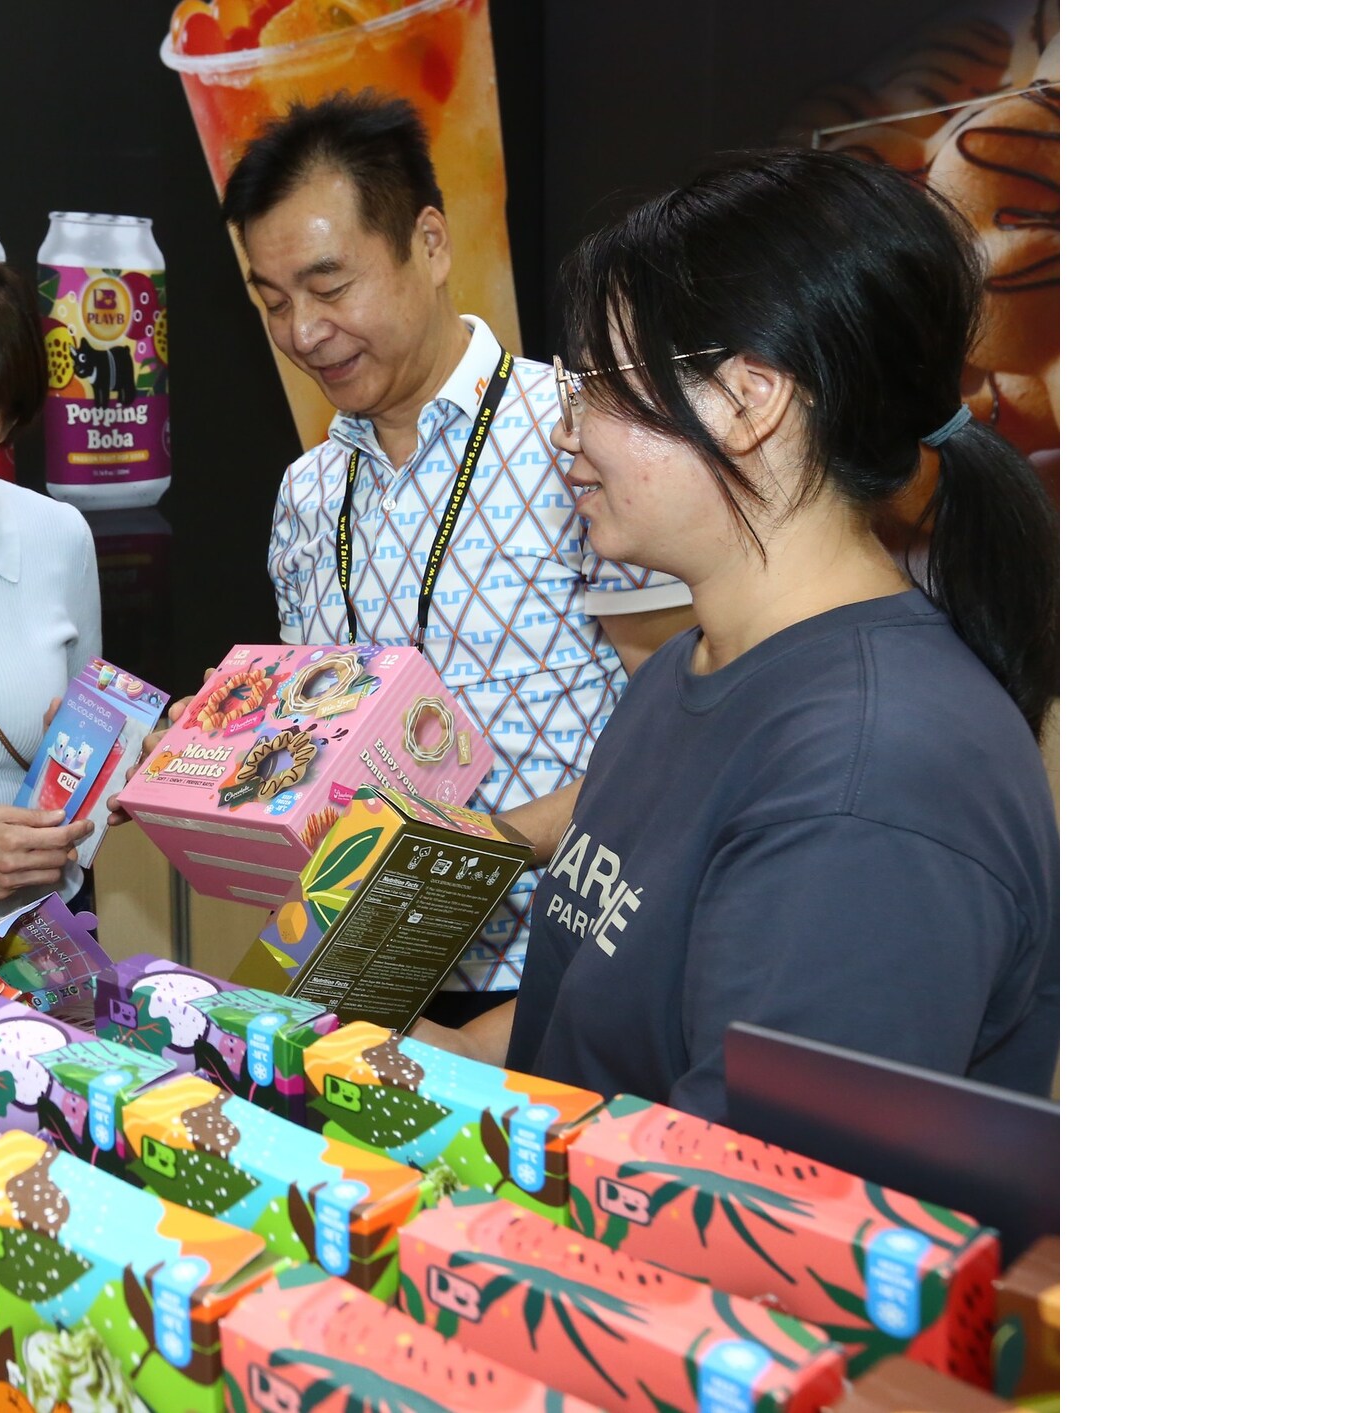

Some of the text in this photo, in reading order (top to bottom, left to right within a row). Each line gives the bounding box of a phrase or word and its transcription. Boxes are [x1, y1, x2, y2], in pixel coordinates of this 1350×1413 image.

[87, 312, 125, 325] PLAYB
[66, 403, 148, 426] Popping
[87, 429, 134, 450] Boba
[423, 407, 492, 596] www.TaiwanTradeShows.com.tw
[380, 654, 399, 665] 12
[67, 700, 113, 733] DELICIOUS WORLD
[77, 693, 112, 719] ENJOY YOUR
[181, 743, 234, 762] Mochi
[164, 758, 227, 778] Donuts
[359, 748, 391, 790] Donuts
[374, 738, 400, 771] Enjoy
[399, 770, 419, 796] your
[33, 911, 61, 941] NSTANT
[546, 893, 597, 939] PARI
[58, 951, 73, 963] KIT
